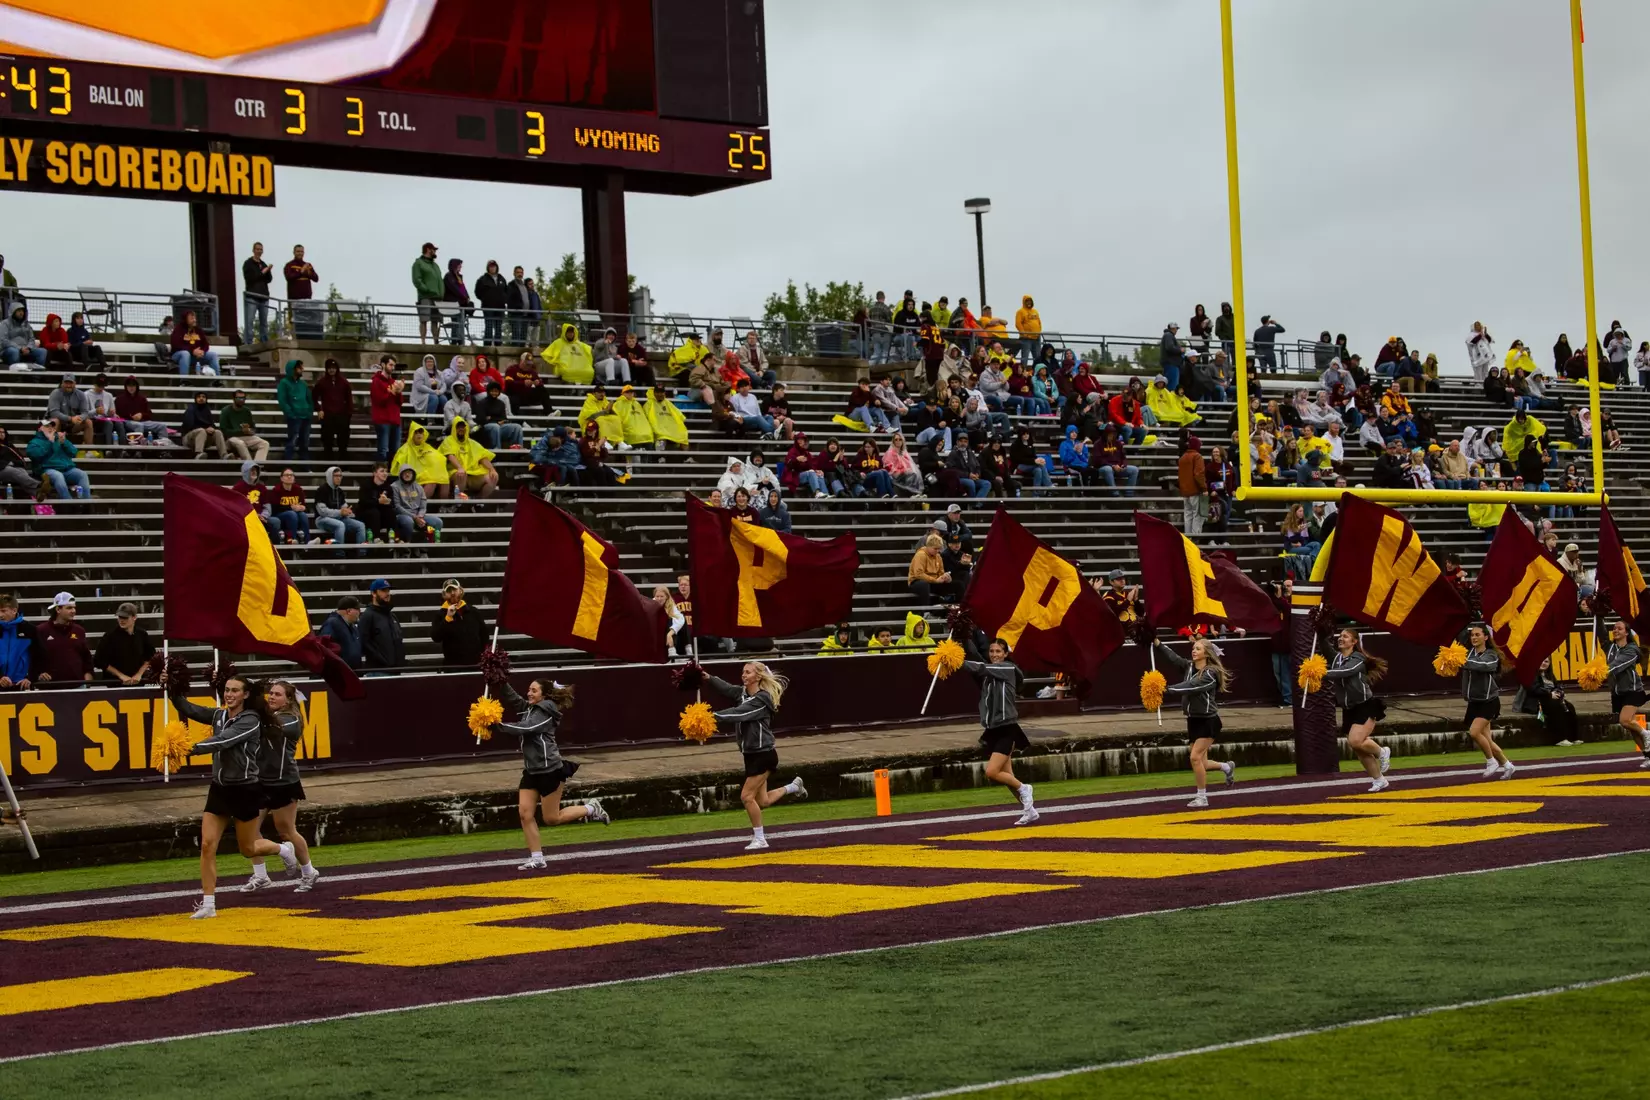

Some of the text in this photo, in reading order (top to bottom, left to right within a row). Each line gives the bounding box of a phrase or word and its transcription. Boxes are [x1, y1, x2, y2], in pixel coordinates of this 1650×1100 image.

[89, 85, 144, 108] BALL ON
[235, 88, 306, 135] QTR 3
[346, 97, 416, 136] 3 T.O.L.
[525, 111, 545, 155] 3
[575, 127, 766, 170] WYOMING 25
[46, 141, 273, 197] SCOREBOARD
[730, 518, 788, 627] P
[1362, 514, 1441, 626] W
[996, 546, 1081, 652] P
